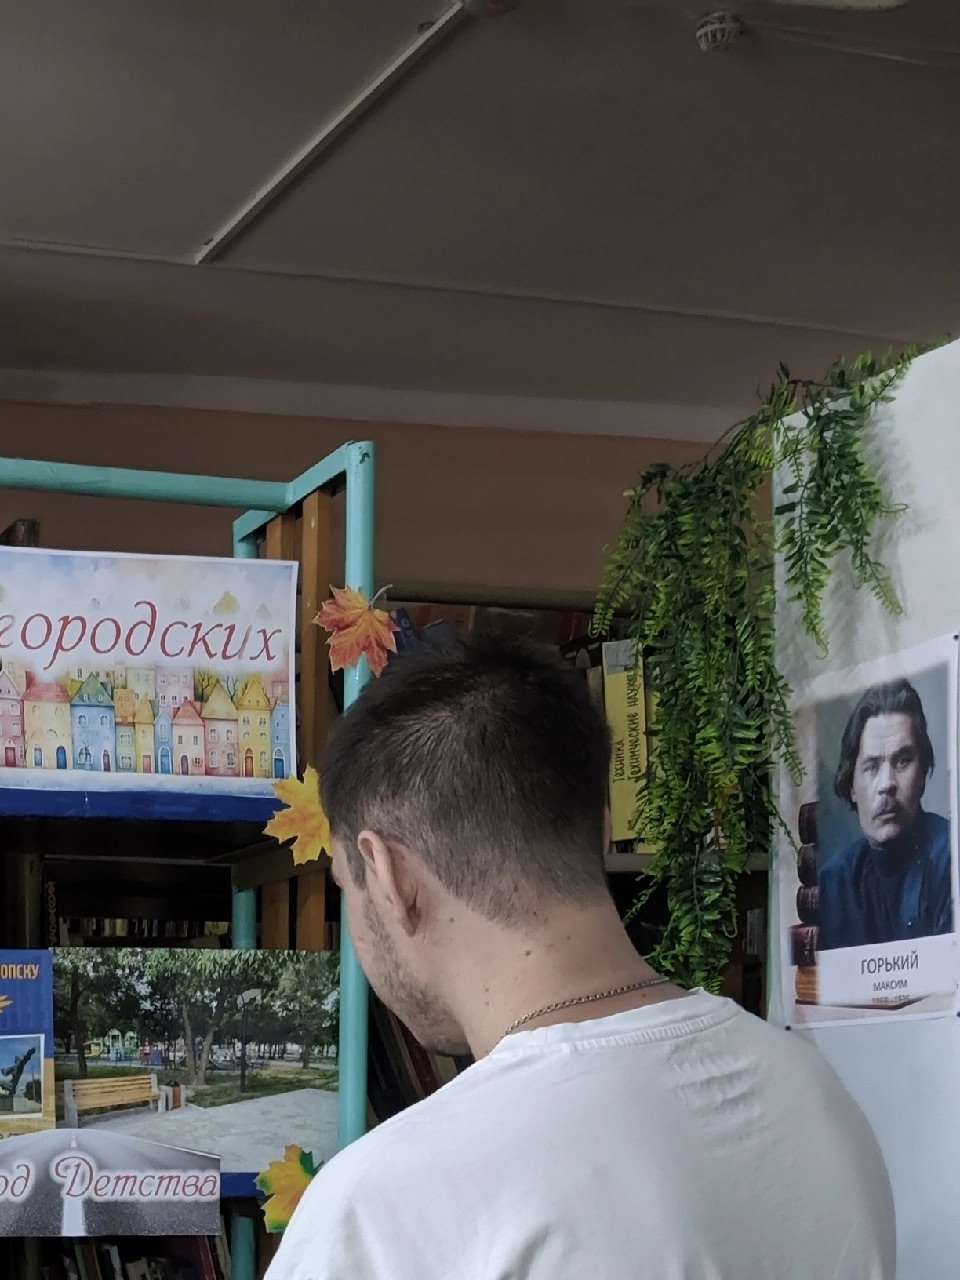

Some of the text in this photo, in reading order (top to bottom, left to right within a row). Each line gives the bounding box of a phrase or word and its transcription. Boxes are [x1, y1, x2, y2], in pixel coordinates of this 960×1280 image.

[861, 950, 919, 975] ГОРЬКИЙ
[873, 979, 908, 992] МАКСИМ
[55, 1154, 218, 1199] Детства
